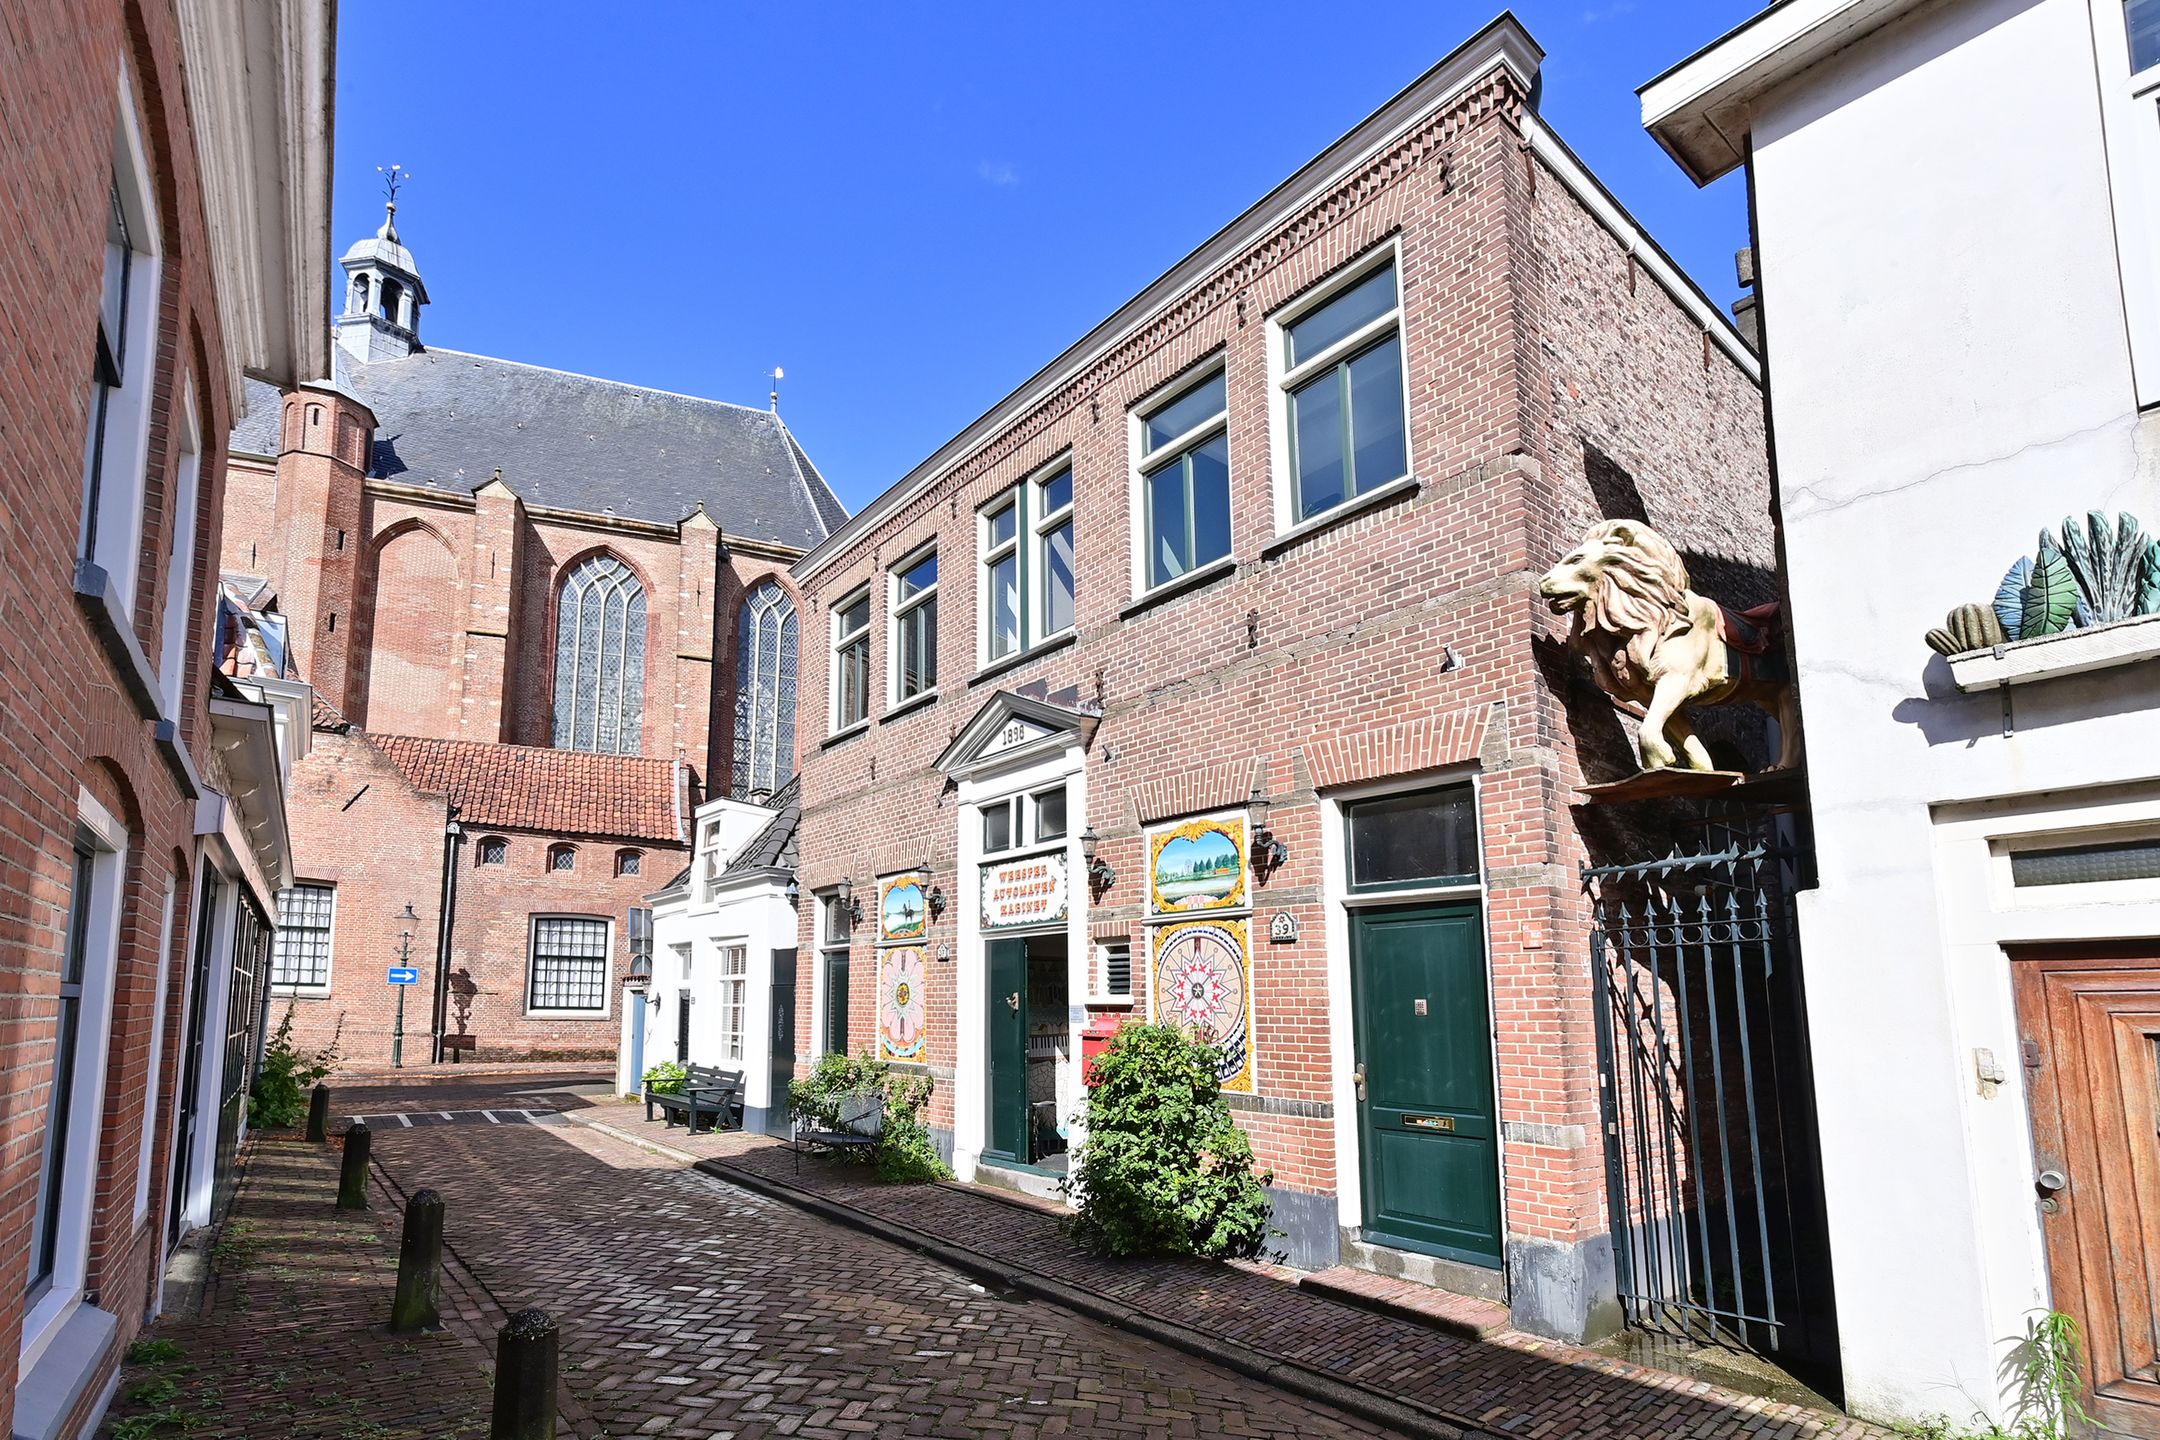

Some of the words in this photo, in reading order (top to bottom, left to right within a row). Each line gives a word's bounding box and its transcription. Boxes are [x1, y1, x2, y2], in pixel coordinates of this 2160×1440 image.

[1003, 724, 1025, 746] 1898
[1000, 865, 1048, 884] WEESPER
[993, 881, 1057, 902] AUTOMATEN
[1000, 899, 1048, 917] KABINET
[1274, 923, 1290, 936] 39
